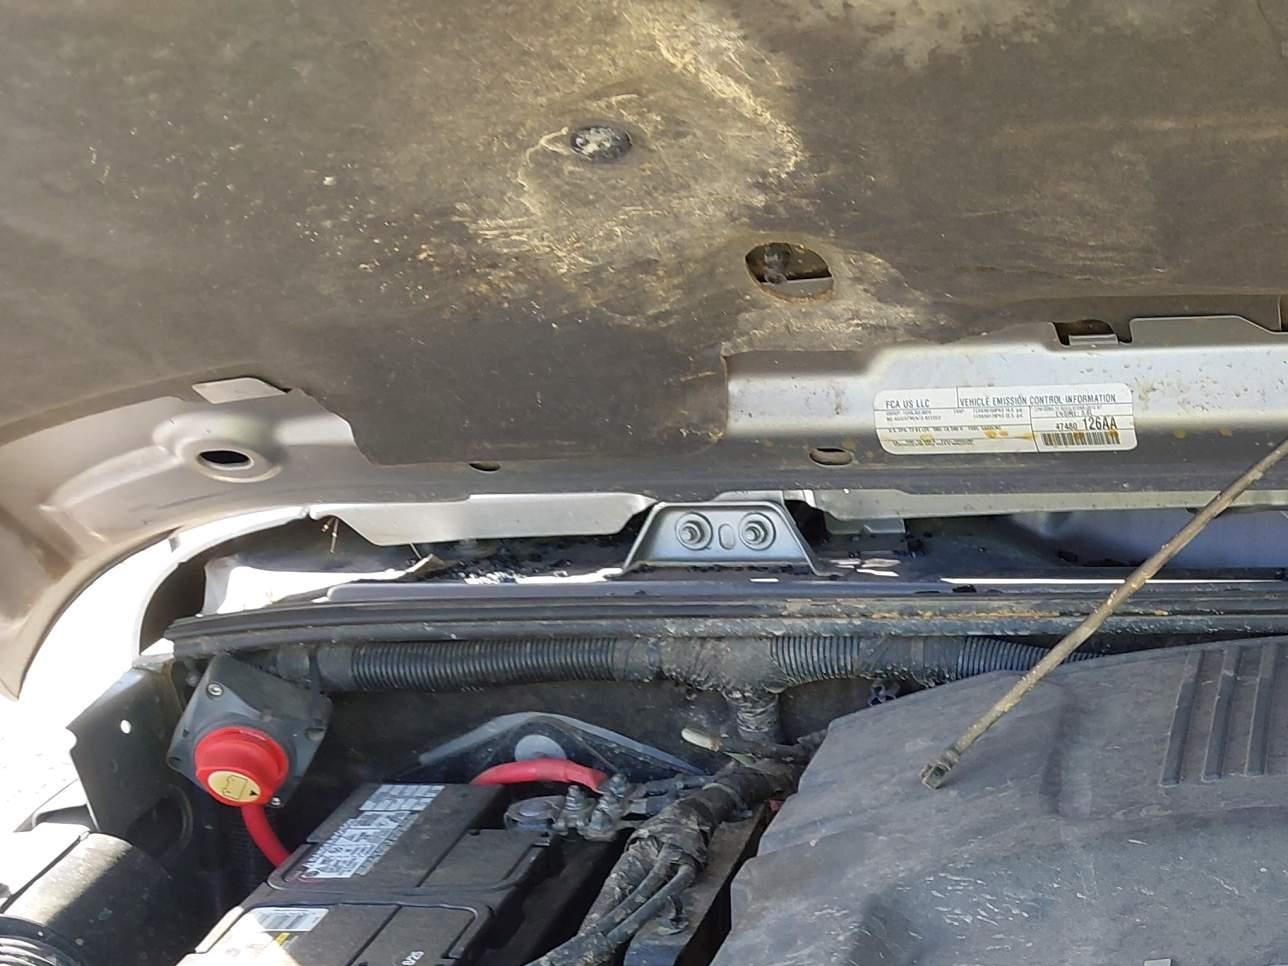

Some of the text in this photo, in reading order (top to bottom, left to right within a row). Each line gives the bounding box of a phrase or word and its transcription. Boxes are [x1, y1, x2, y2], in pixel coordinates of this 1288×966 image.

[886, 399, 930, 409] FCA US LLC
[960, 394, 1116, 407] VEHICLE EMISSION CONTROL INFORMATION
[1082, 416, 1118, 430] 126AA
